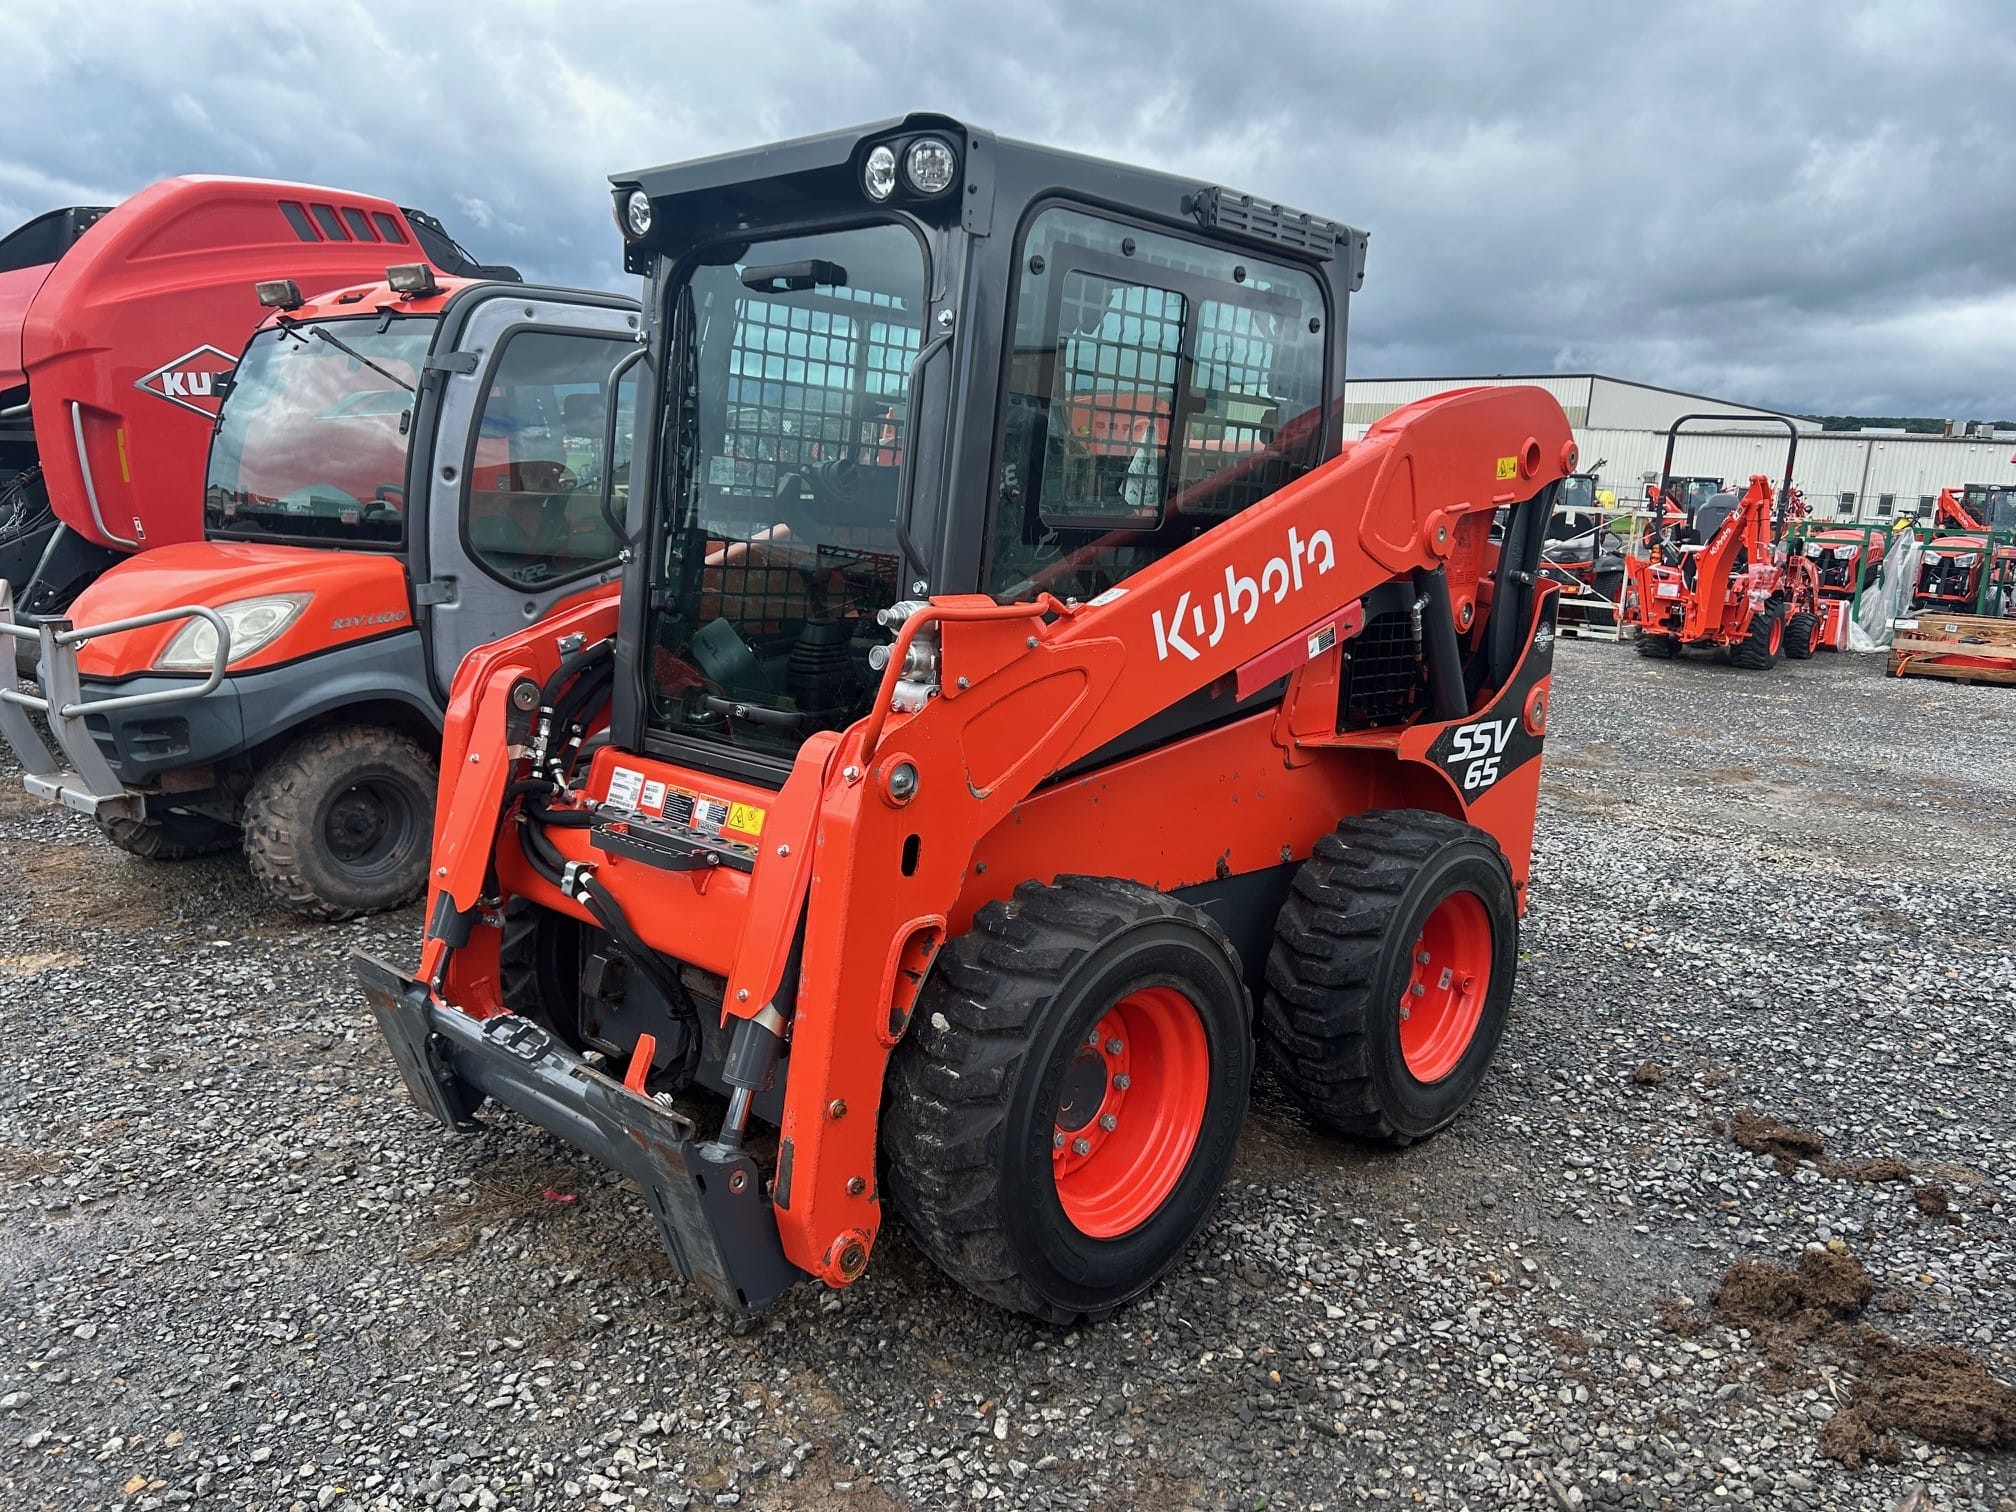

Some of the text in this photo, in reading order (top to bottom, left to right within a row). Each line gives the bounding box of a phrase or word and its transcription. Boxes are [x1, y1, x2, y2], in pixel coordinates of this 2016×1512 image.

[161, 371, 212, 396] KU
[1151, 526, 1335, 662] Kubota
[1447, 717, 1518, 764] SSV
[1464, 756, 1502, 790] 65
